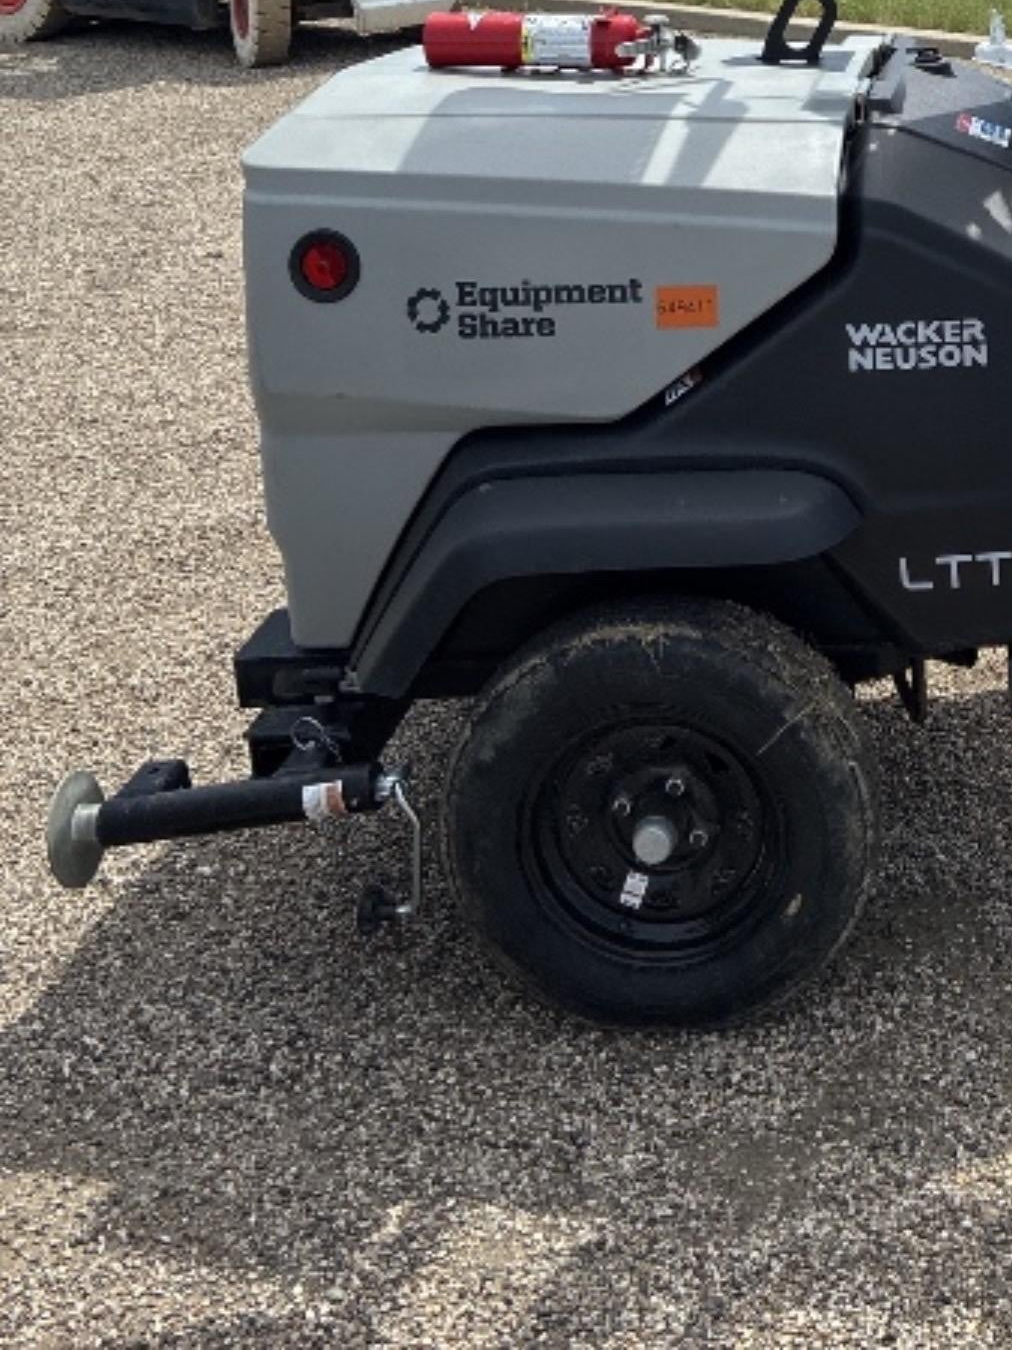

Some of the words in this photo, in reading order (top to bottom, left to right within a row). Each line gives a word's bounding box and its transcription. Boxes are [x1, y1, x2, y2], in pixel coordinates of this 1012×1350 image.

[455, 278, 643, 312] Equipment
[457, 313, 556, 339] Share
[845, 318, 987, 346] WACKER
[848, 343, 988, 373] NEUSON
